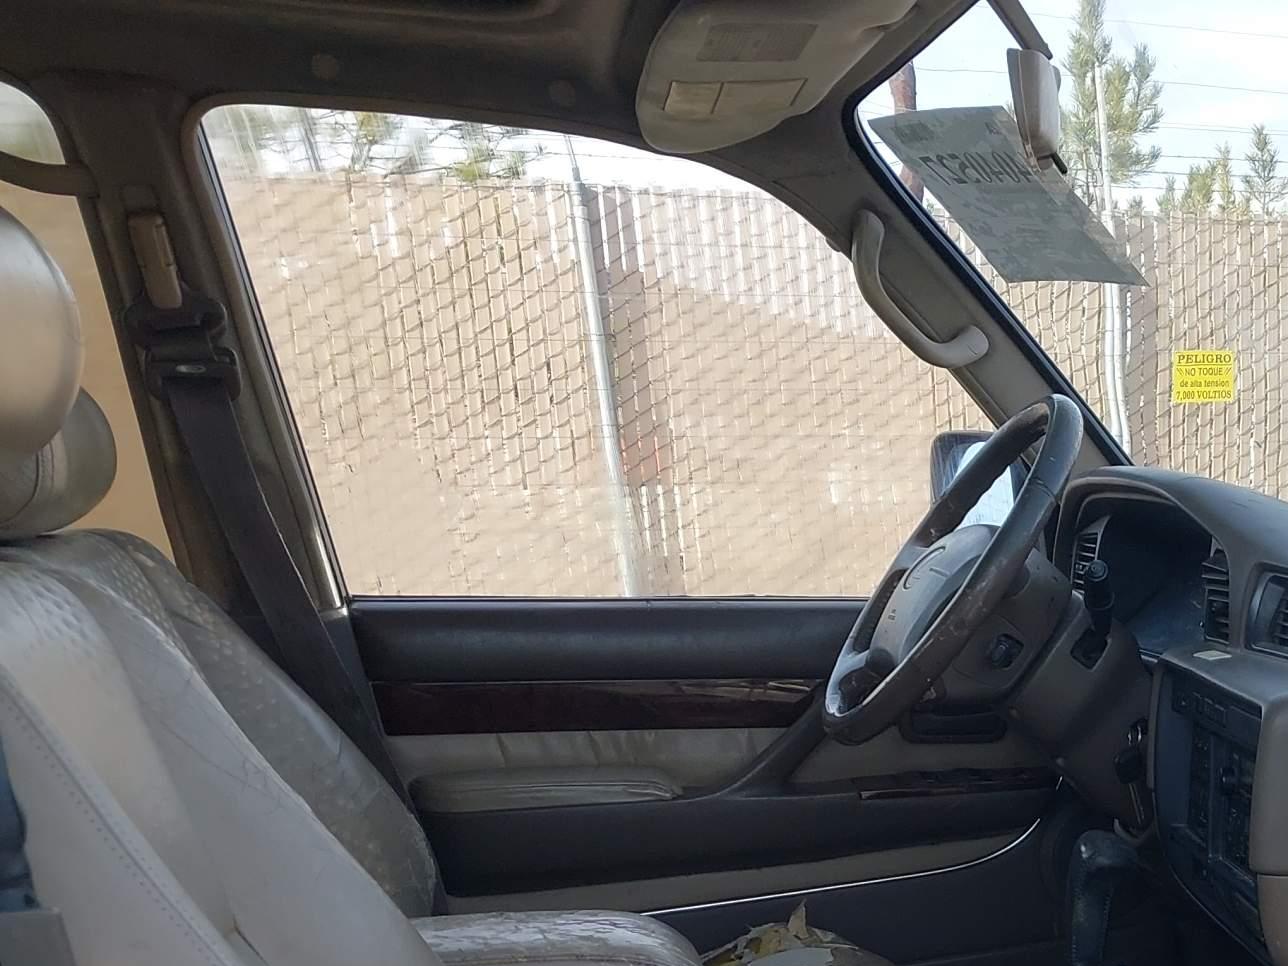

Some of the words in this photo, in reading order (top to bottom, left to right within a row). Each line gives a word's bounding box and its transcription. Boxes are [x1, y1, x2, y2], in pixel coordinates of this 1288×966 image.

[1177, 354, 1231, 364] PELIGRO
[1185, 367, 1196, 376] NO
[1198, 367, 1223, 376] TOQUE
[1180, 379, 1189, 387] de
[1176, 390, 1195, 400] 7,000
[1197, 390, 1231, 399] VOLTIOS
